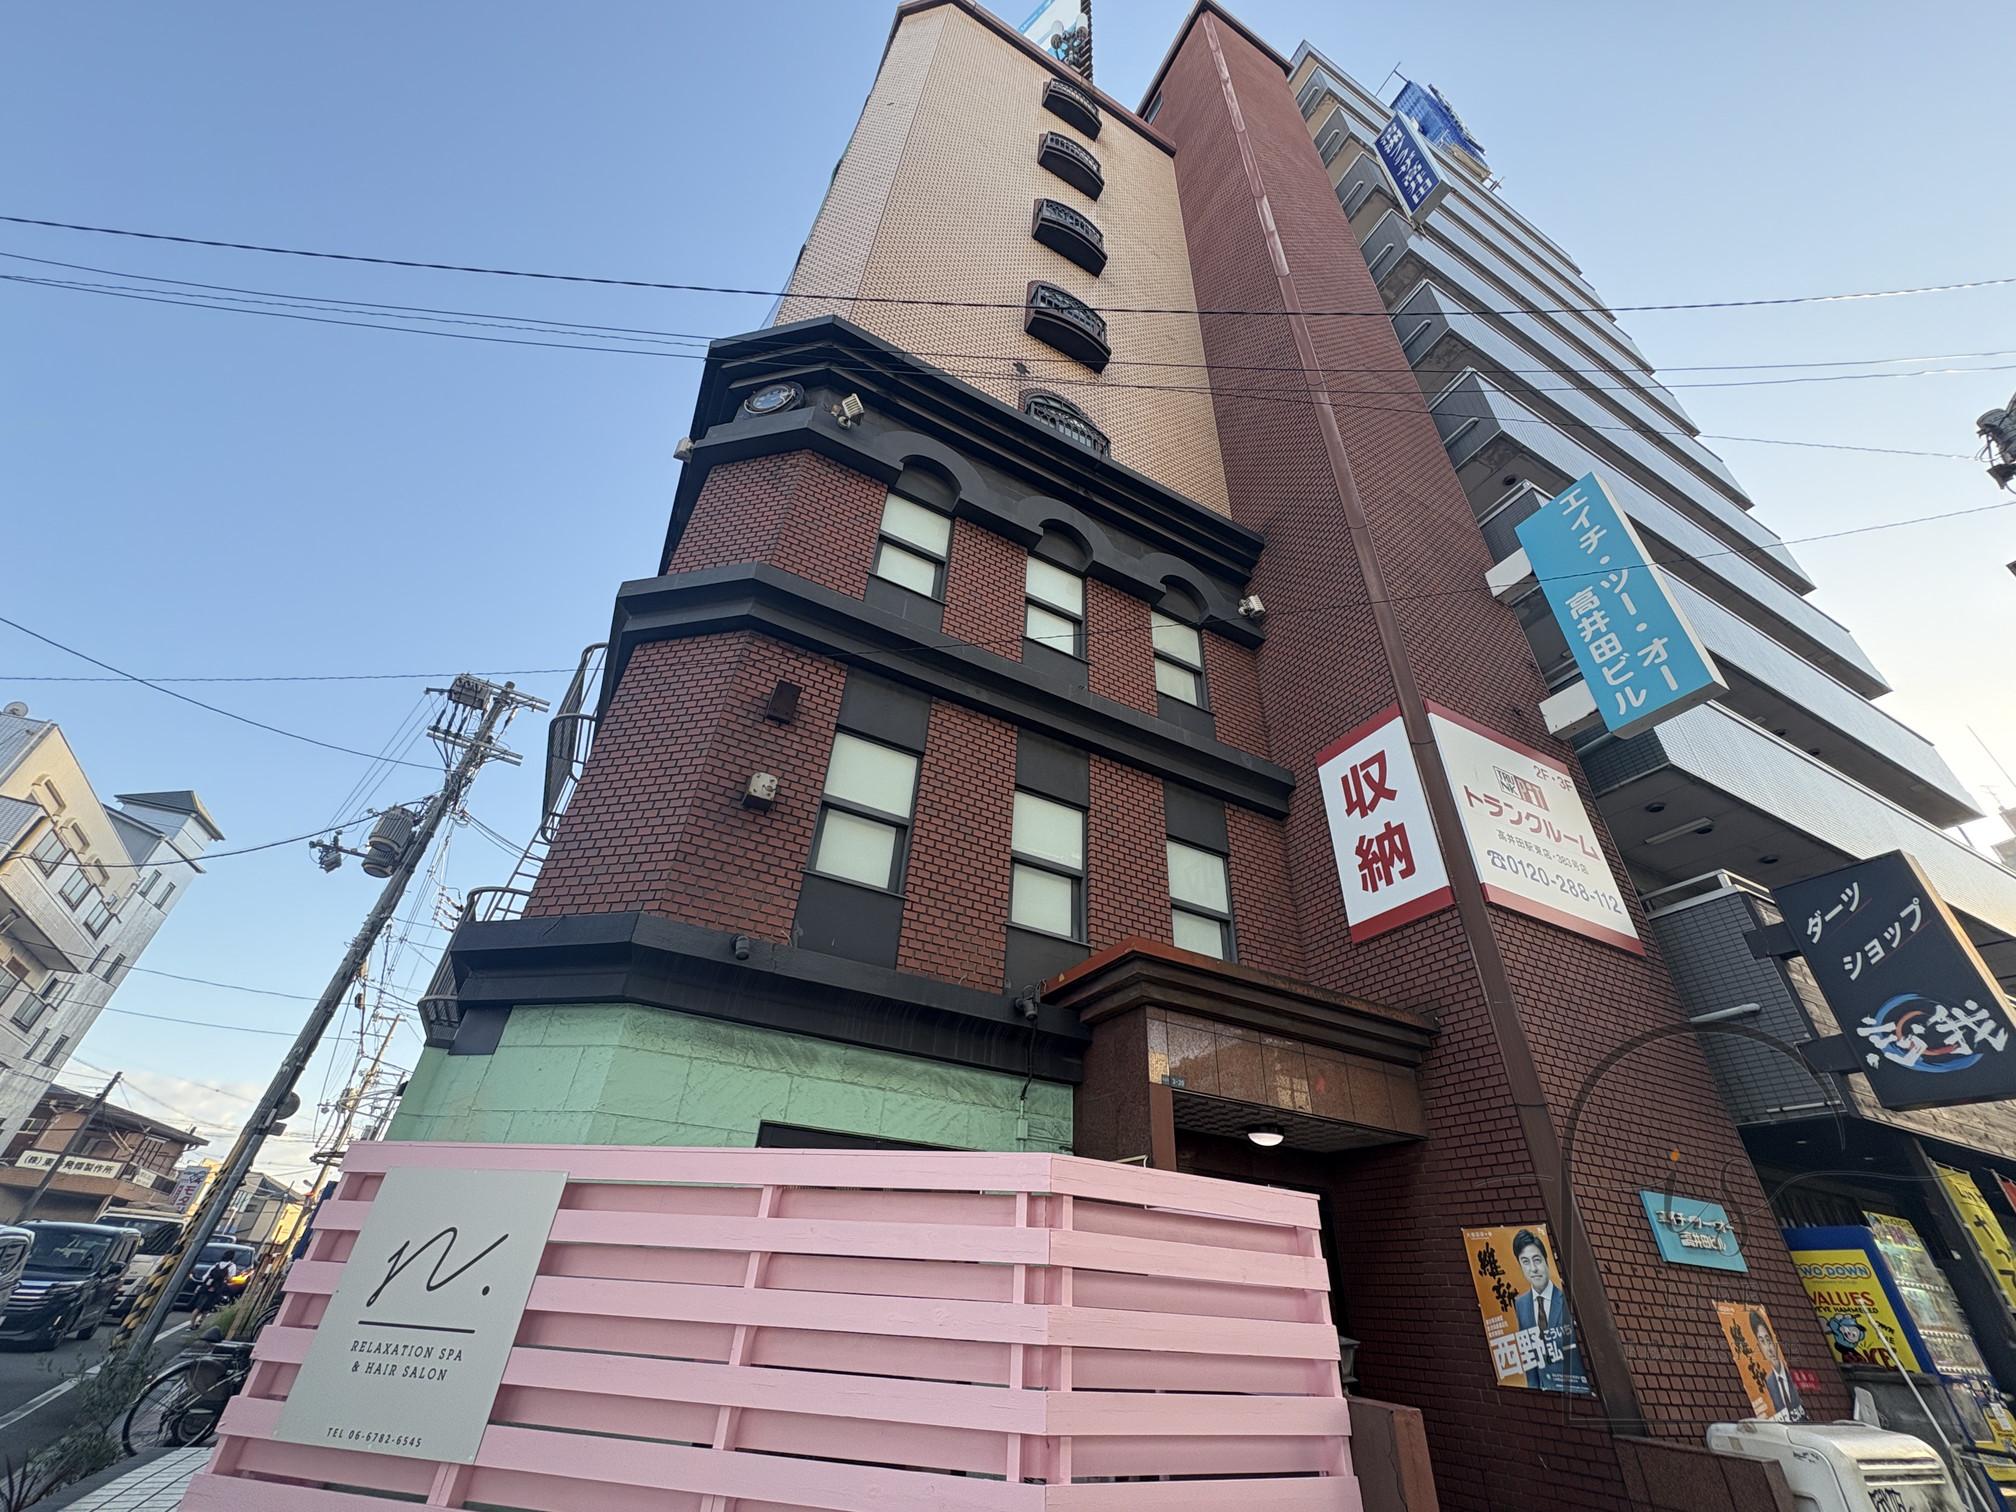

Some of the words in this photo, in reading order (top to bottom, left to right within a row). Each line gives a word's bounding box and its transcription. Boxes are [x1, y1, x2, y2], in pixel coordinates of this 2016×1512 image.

[1557, 486, 1680, 692] エイチ・ツー・オー
[1563, 584, 1648, 716] 高井田ビル
[1342, 749, 1416, 893] 収納
[1462, 783, 1601, 861] トランクルーム
[1504, 852, 1623, 916] 0120-288-112
[1806, 881, 1861, 944] ダーツ
[1843, 897, 1922, 981] ショップ
[1476, 1241, 1520, 1313] 維新
[1825, 1266, 1869, 1276] DOWN
[350, 1340, 434, 1360] RELAXATION
[438, 1347, 463, 1362] SPA
[1489, 1326, 1546, 1380] 西野
[1543, 1324, 1573, 1341] こういち
[351, 1362, 360, 1373] &
[365, 1363, 397, 1377] HAIR
[402, 1366, 448, 1381] SALON
[327, 1427, 343, 1439] TEL
[349, 1430, 422, 1448] 06-6782-6545
